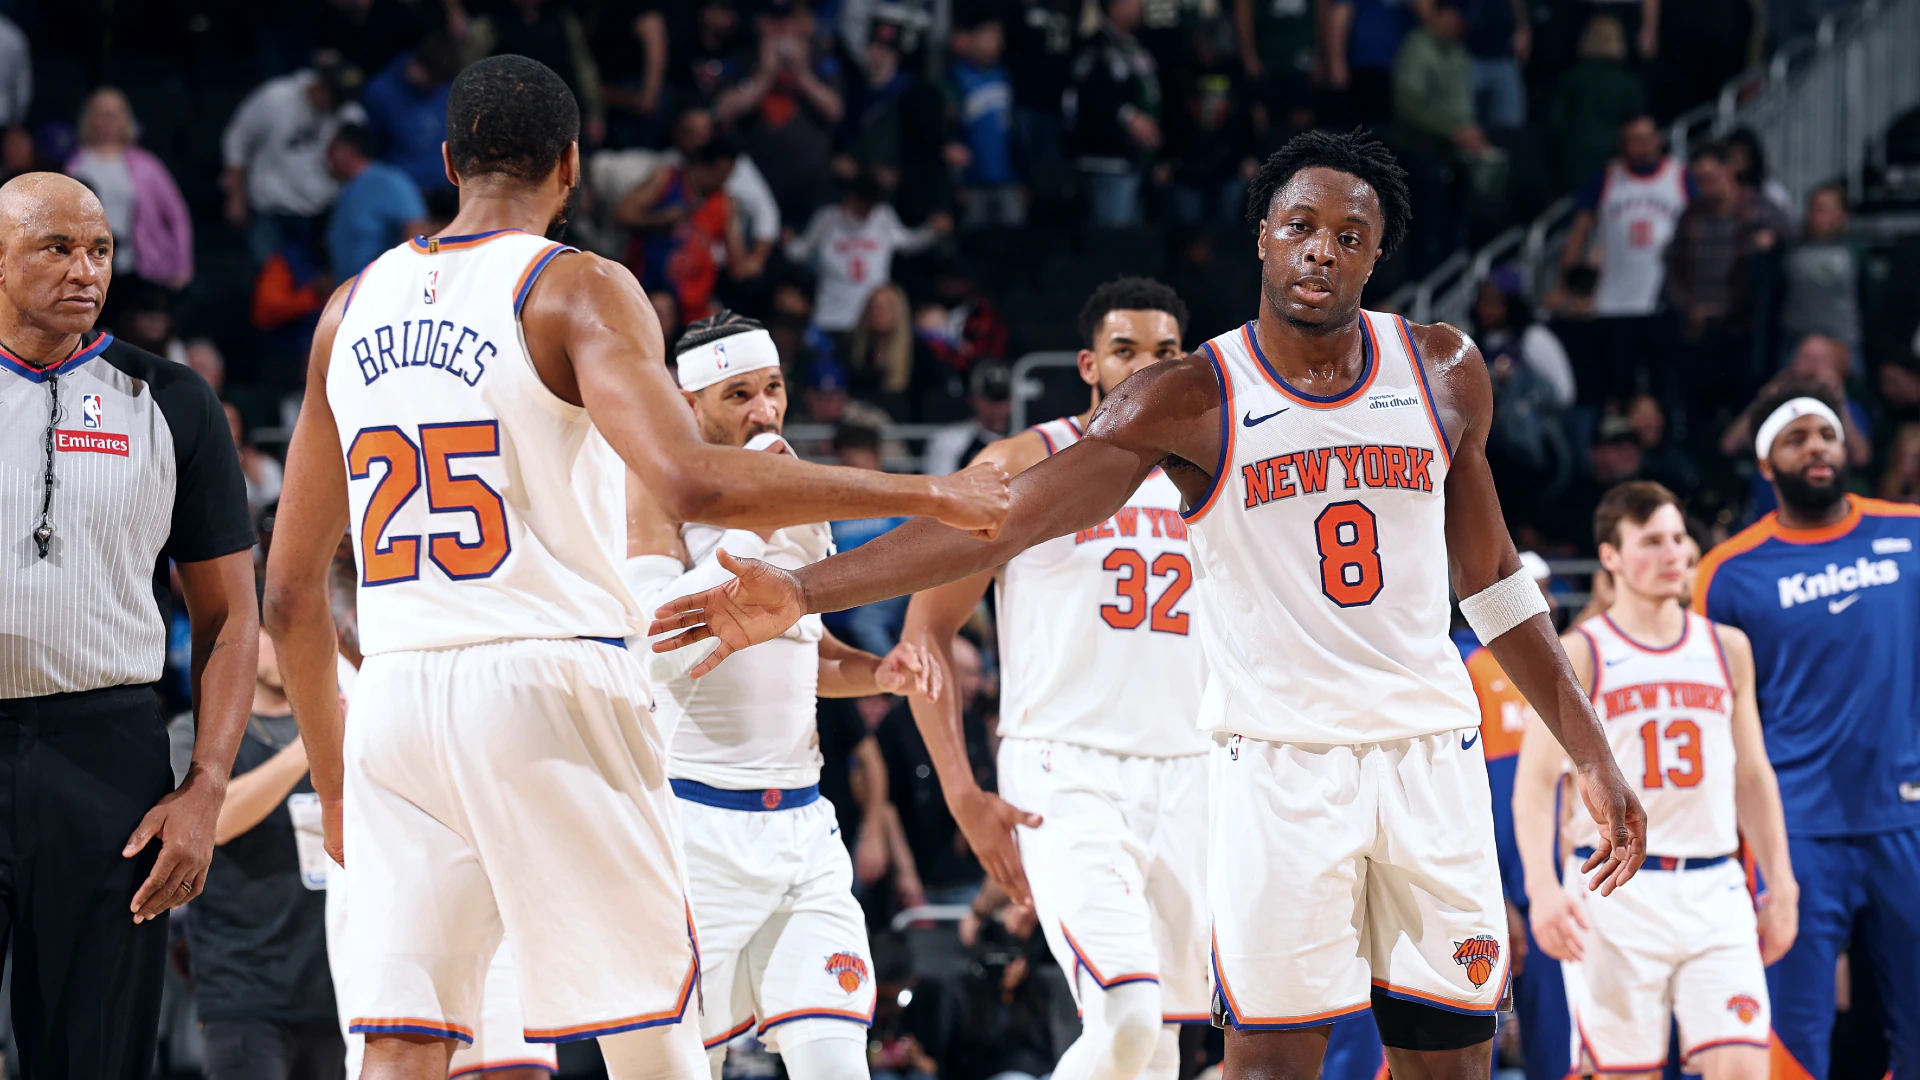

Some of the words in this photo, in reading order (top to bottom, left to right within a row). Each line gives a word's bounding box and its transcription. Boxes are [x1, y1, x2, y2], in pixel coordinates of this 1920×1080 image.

[352, 319, 497, 387] BRIDGES
[1369, 400, 1389, 409] abu
[1390, 396, 1419, 407] dhabi
[58, 434, 128, 451] Emirates
[347, 419, 512, 587] 25
[1241, 446, 1332, 511] NEW
[1334, 443, 1435, 494] YORK
[1314, 500, 1384, 608] 8
[1777, 557, 1899, 609] Knicks
[1101, 548, 1193, 636] 32
[1603, 683, 1660, 720] NEW
[1663, 682, 1726, 715] YORK
[1640, 719, 1704, 788] 13
[1453, 938, 1499, 961] KNICKS
